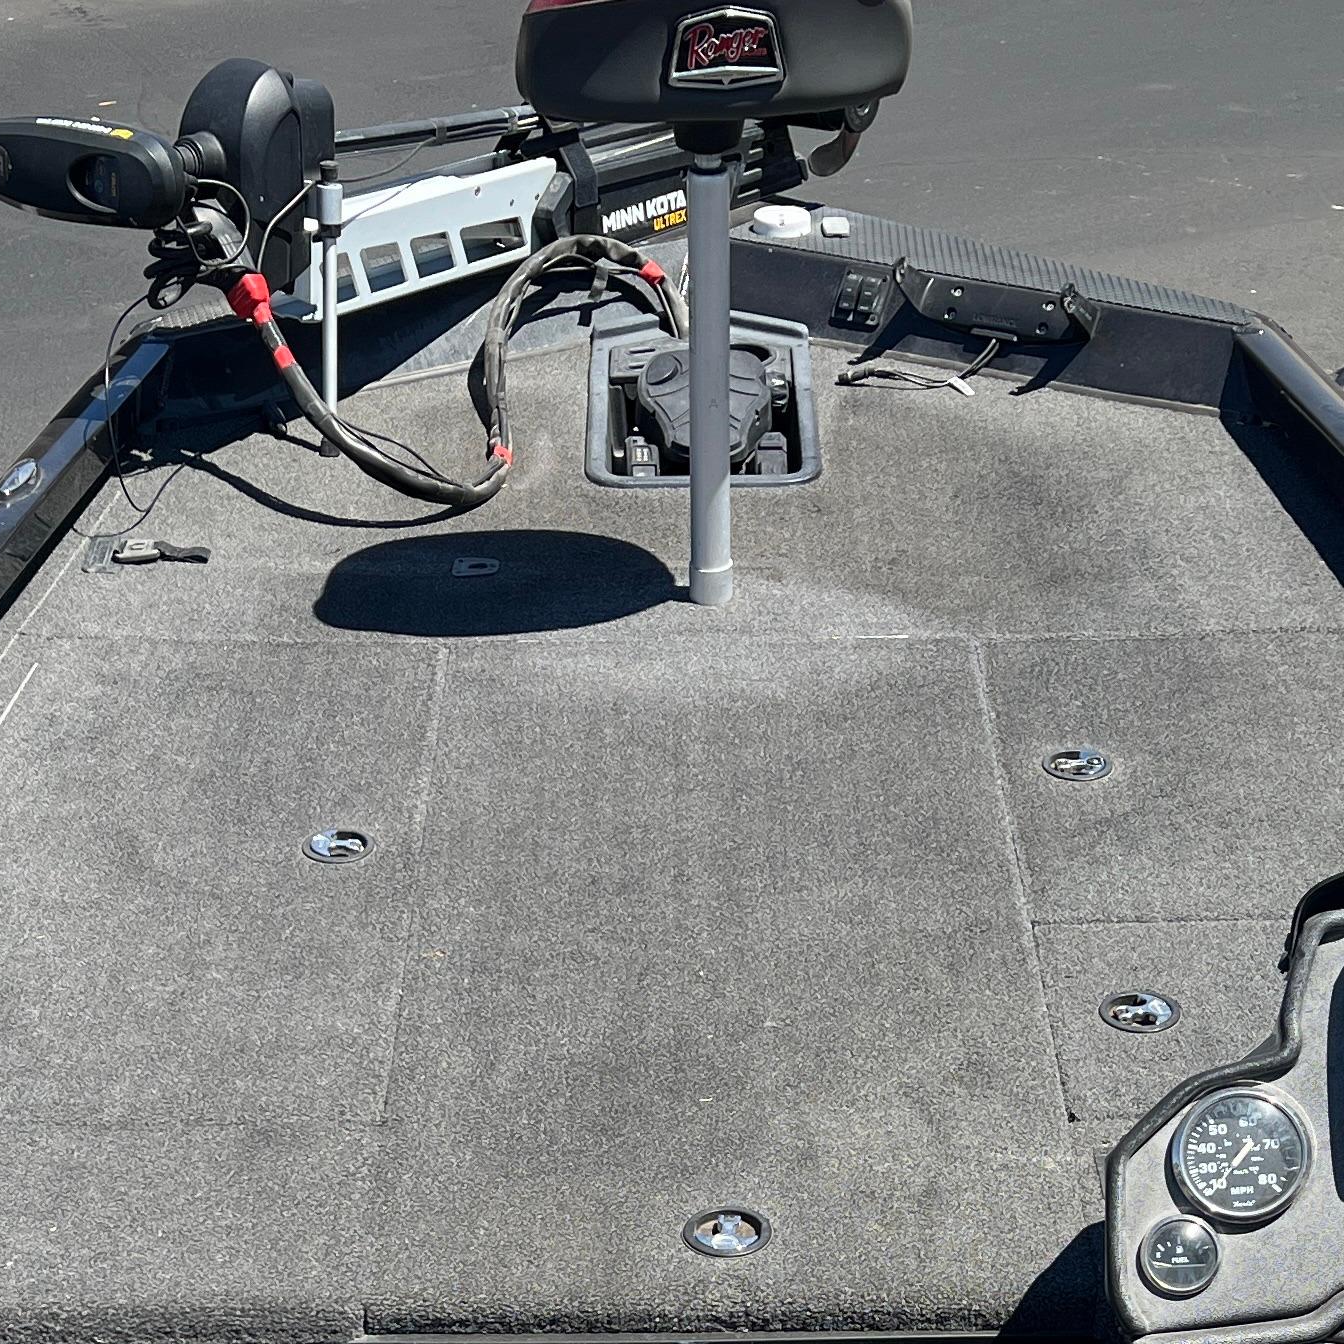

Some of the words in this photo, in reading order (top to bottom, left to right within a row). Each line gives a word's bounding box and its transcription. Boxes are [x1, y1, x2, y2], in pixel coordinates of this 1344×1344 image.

[684, 22, 768, 69] Ranger
[601, 202, 645, 234] MINN
[645, 189, 687, 219] KOTA
[653, 208, 687, 231] ULTREX
[1239, 1115, 1258, 1127] 60
[1209, 1124, 1227, 1136] 50
[1197, 1142, 1216, 1153] 40
[1262, 1138, 1280, 1149] 70
[1199, 1162, 1217, 1173] 30
[1258, 1173, 1277, 1185] 80
[1230, 1185, 1255, 1195] MPH
